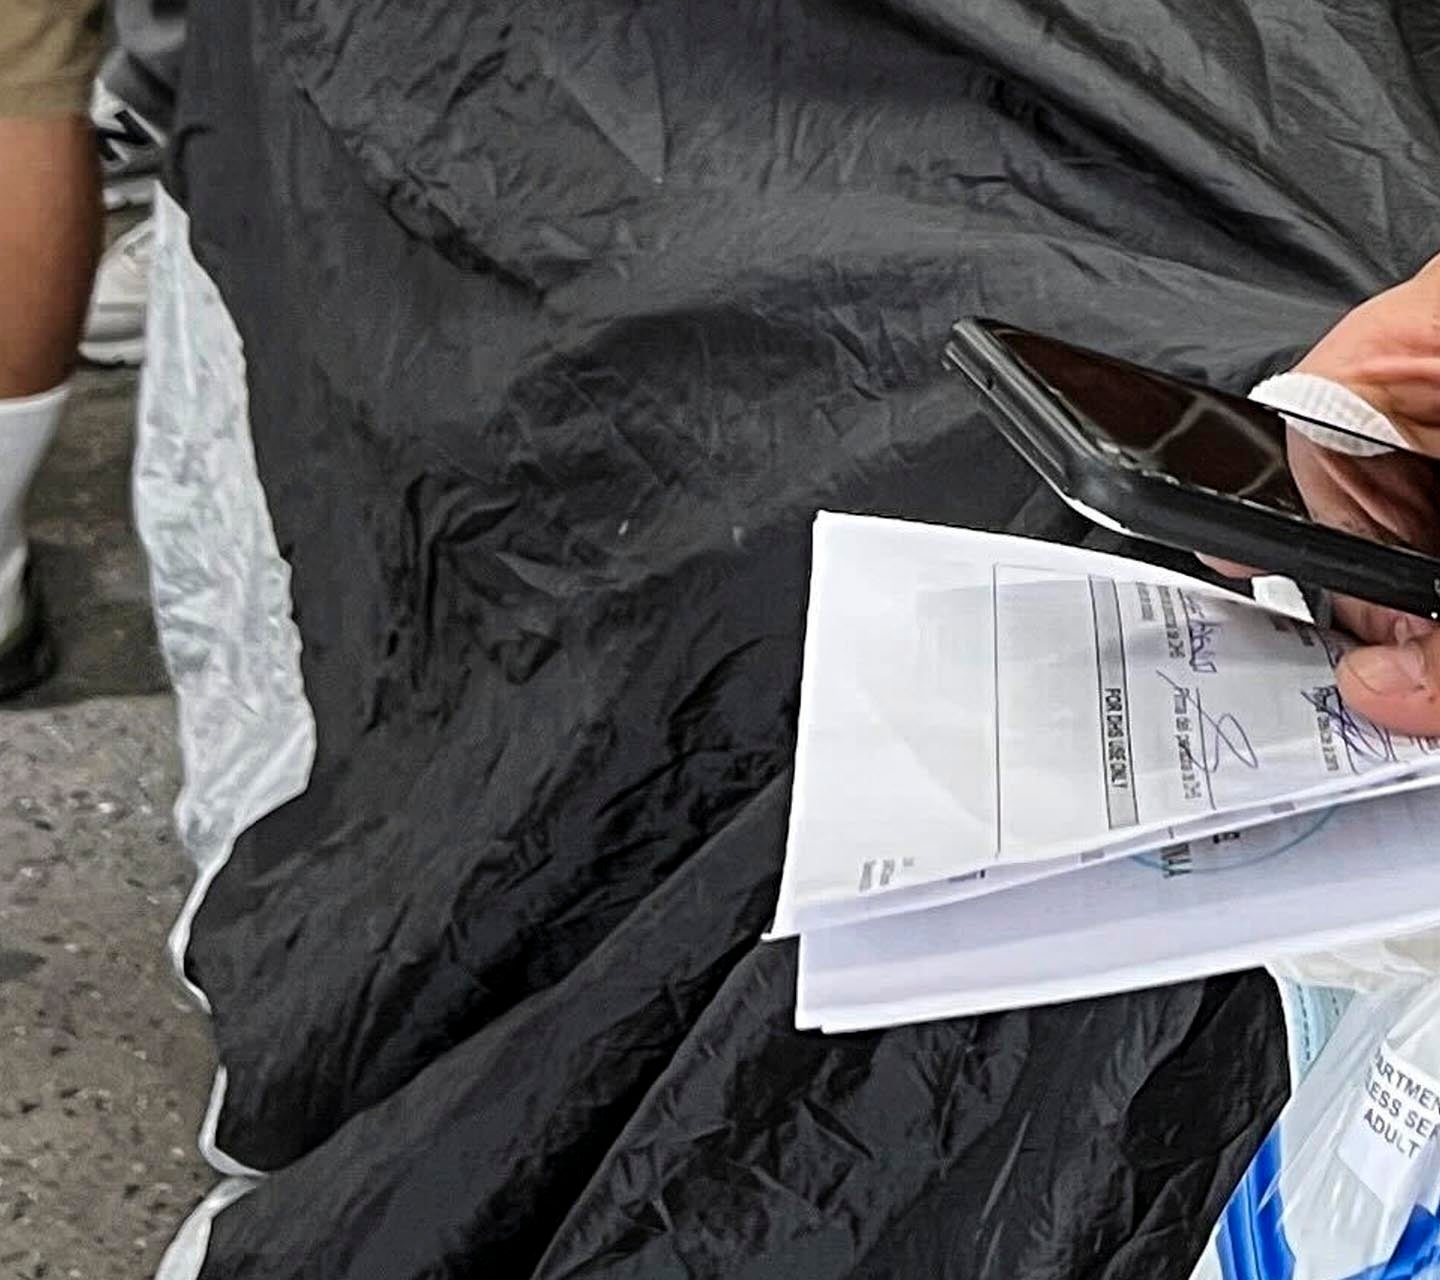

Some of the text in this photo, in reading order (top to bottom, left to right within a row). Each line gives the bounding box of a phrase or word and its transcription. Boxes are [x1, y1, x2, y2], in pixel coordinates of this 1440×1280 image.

[1104, 688, 1123, 711] FOR
[1108, 740, 1127, 761] USE
[1109, 763, 1129, 788] ONLY
[1363, 1108, 1421, 1158] ADULT
